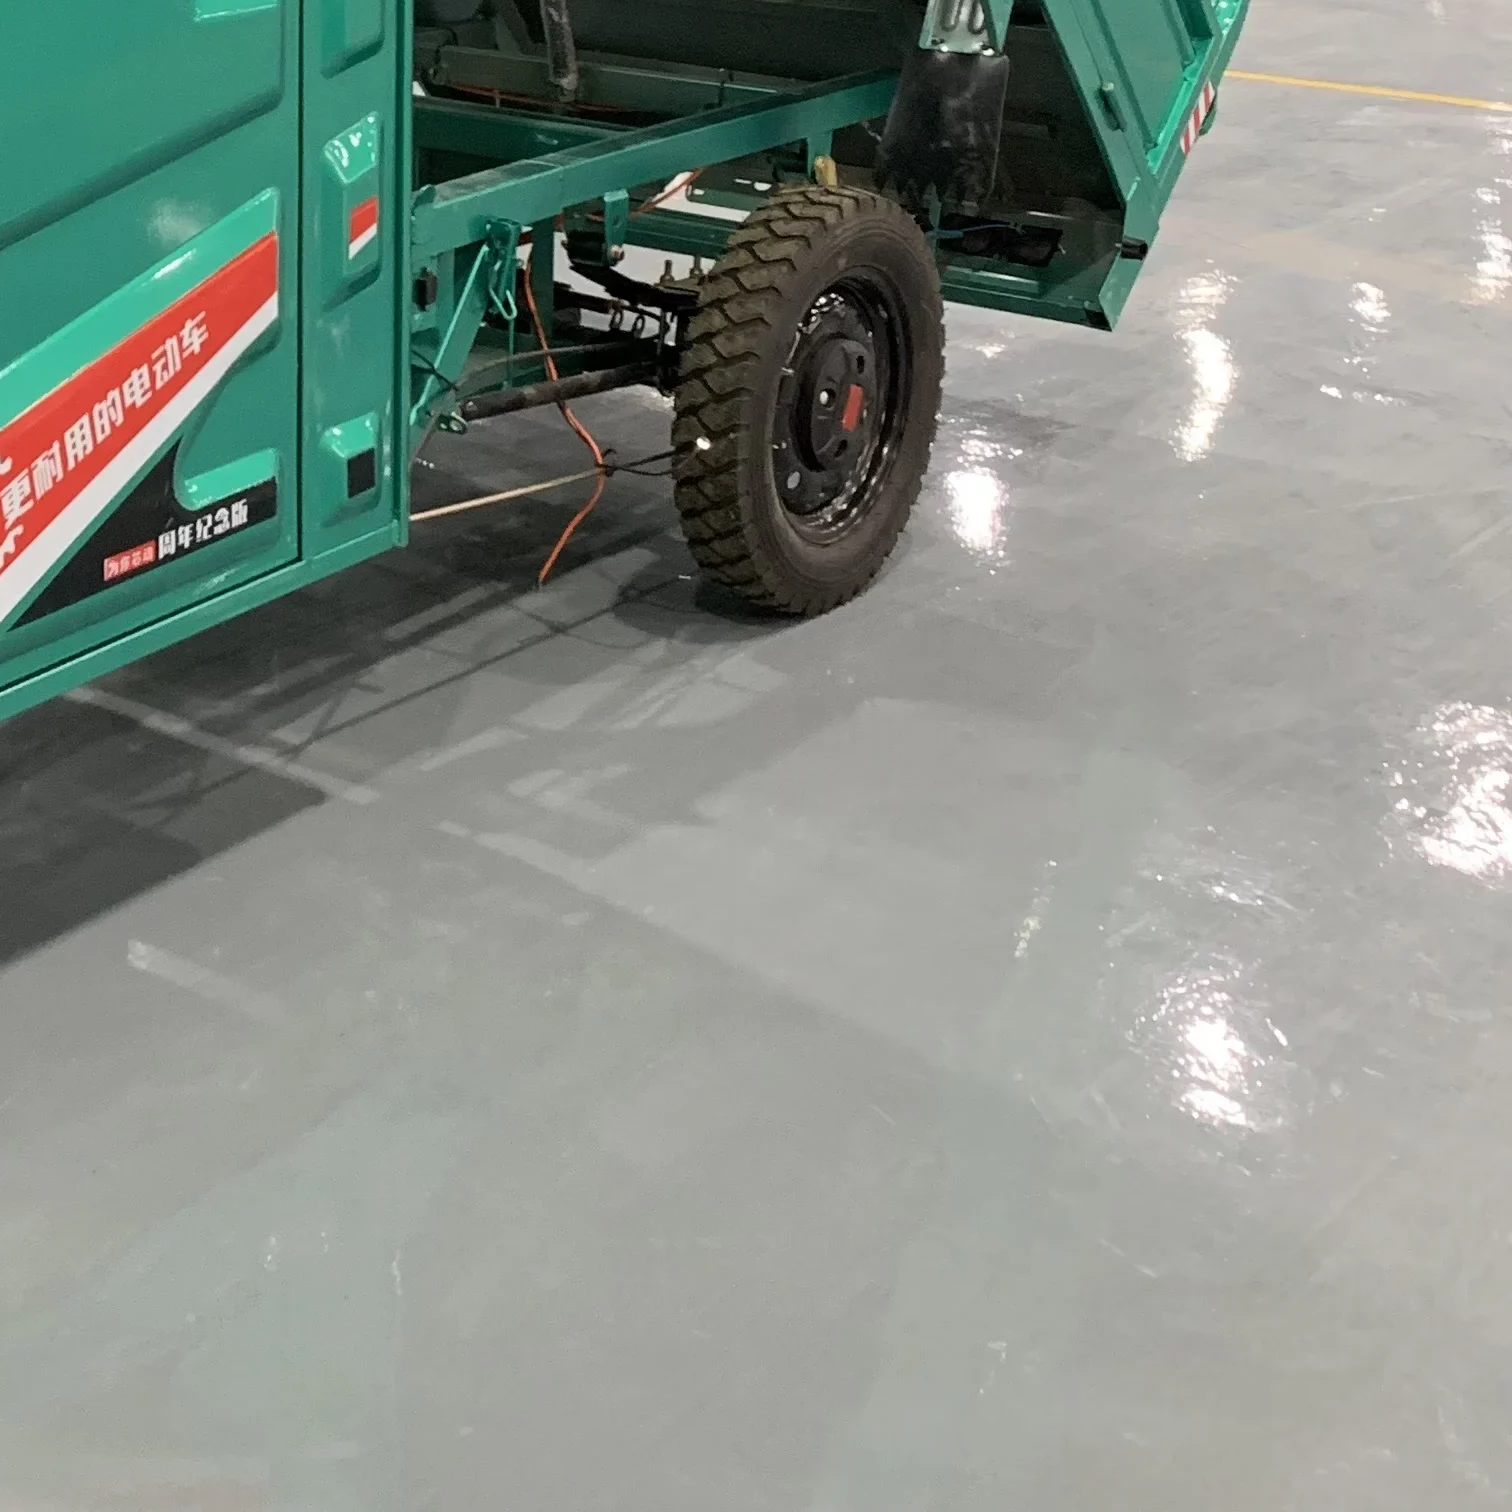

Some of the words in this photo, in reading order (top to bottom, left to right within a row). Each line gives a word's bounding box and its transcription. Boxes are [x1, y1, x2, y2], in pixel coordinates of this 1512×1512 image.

[0, 311, 209, 530] 更耐用的电动车
[158, 498, 248, 560] 周年纪念版
